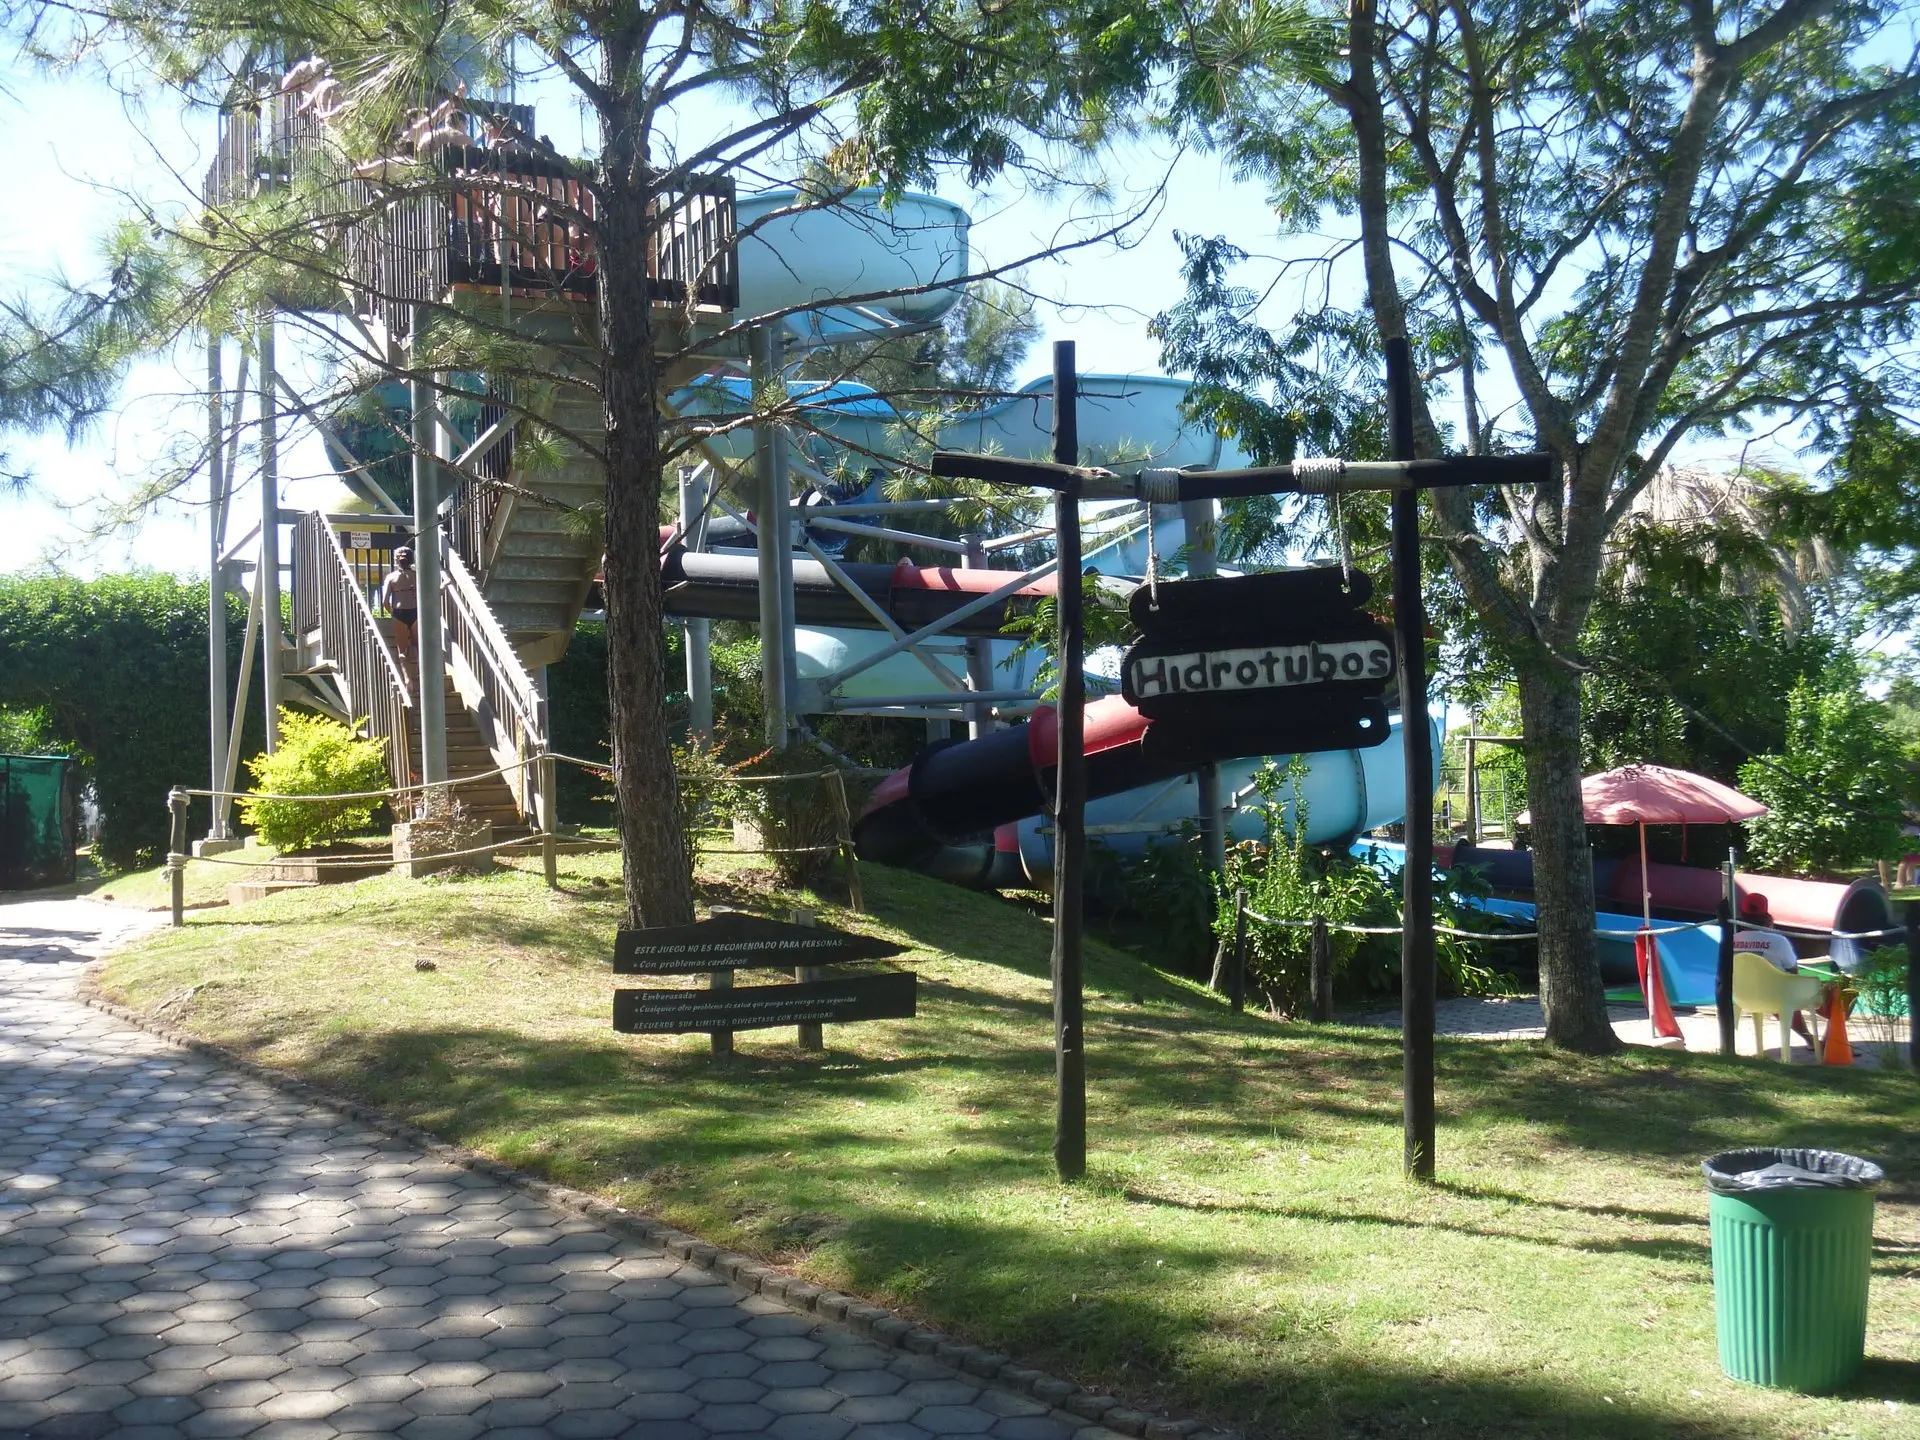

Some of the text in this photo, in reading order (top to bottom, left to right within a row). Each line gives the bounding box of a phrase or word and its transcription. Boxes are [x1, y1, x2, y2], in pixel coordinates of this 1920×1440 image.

[1135, 641, 1388, 695] Hidrotubos
[634, 946, 656, 955] ESTE
[657, 945, 686, 954] JUEGO
[687, 944, 699, 953] NO
[701, 943, 712, 952] ES
[713, 941, 777, 952] RECOMENDADO
[779, 940, 800, 949] PARA
[639, 960, 657, 969] Con
[658, 959, 706, 970] problemas
[639, 1004, 676, 1015] Cualquier
[677, 1003, 692, 1012] otro
[692, 1003, 723, 1012] problema
[733, 1001, 751, 1009] salud
[752, 1001, 764, 1010] que
[633, 1012, 834, 1030] RECUERDE SUS LIMITES, DIVIERTASE CON SEGURIDAD
